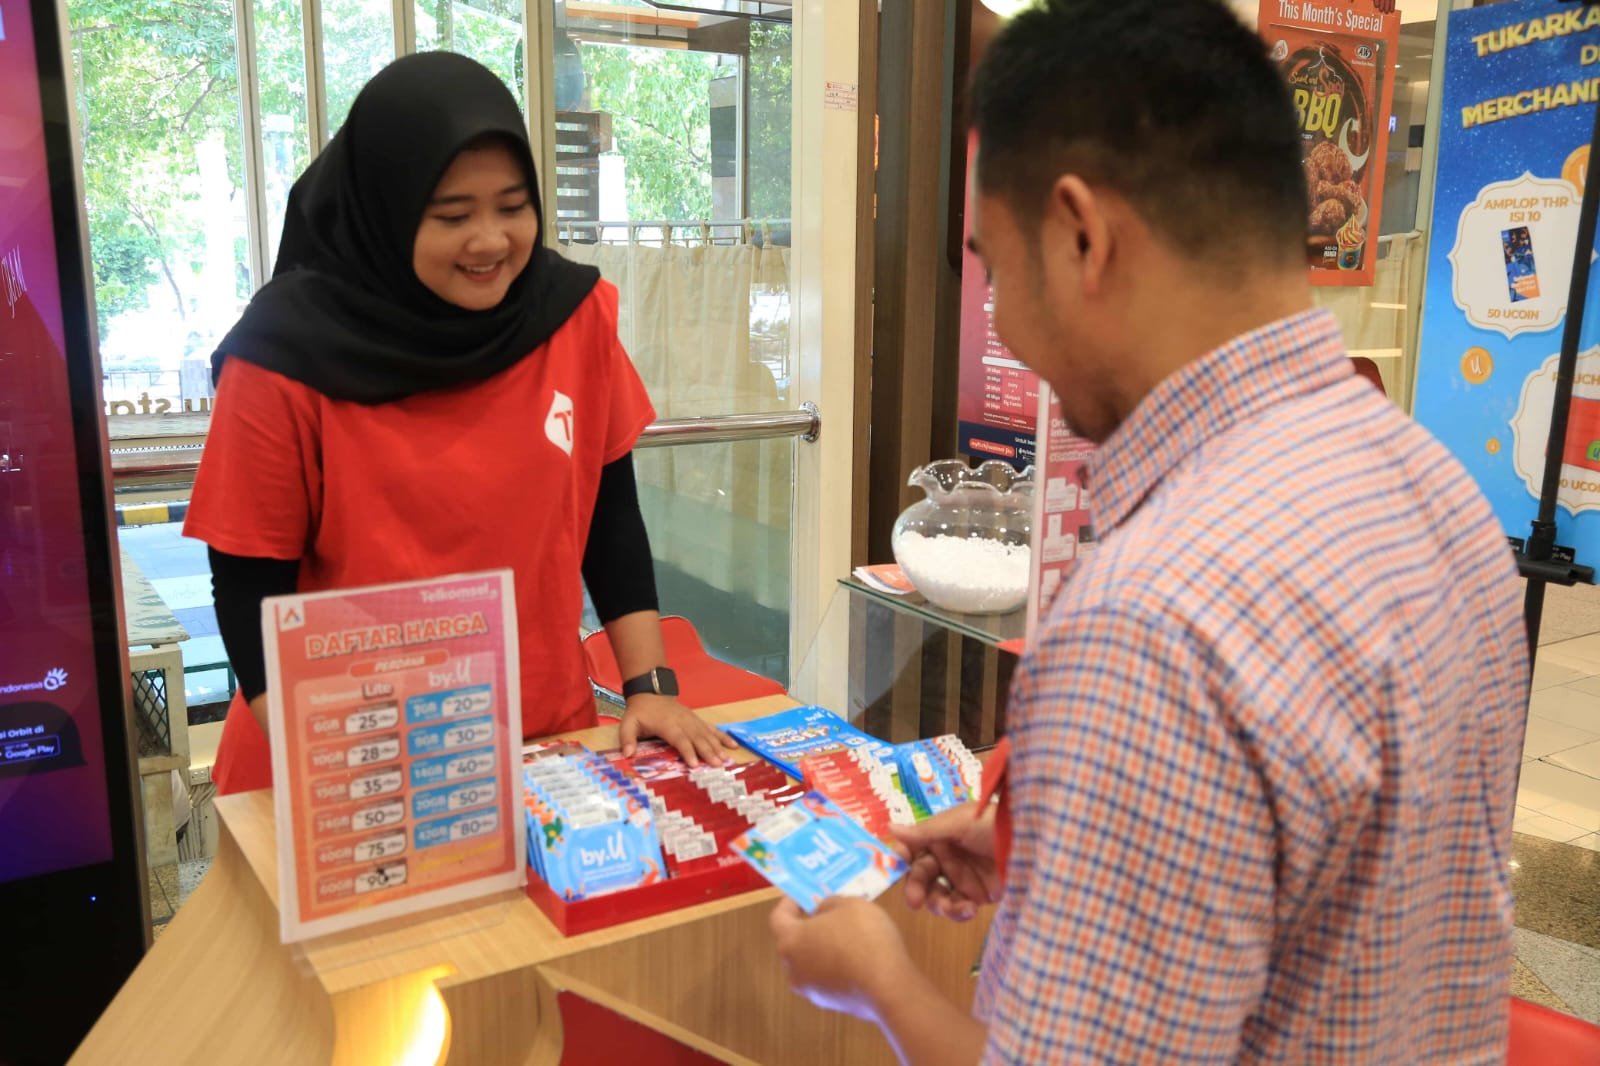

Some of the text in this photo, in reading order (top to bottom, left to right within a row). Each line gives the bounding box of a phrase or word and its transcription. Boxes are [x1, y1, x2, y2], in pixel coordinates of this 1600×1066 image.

[1279, 0, 1384, 32] This Month's Special
[1484, 196, 1569, 210] AMPLOP THR
[1509, 211, 1541, 222] ISI 10
[1487, 308, 1540, 319] 50 UCOIN
[420, 583, 489, 603] Telkomsel
[305, 611, 489, 660] DAFTAR HARGA
[363, 682, 393, 699] Lite
[454, 697, 473, 713] 20
[359, 713, 378, 729] 25
[7, 727, 33, 738] Orbit
[34, 724, 45, 734] di
[455, 728, 475, 744] 30
[5, 747, 37, 759] Google
[37, 744, 55, 755] Play
[361, 746, 380, 762] 28
[457, 759, 478, 774] 40
[363, 779, 382, 794] 35
[459, 790, 479, 806] 50
[365, 810, 385, 826] 50
[461, 820, 481, 836] 80
[367, 842, 385, 858] 75
